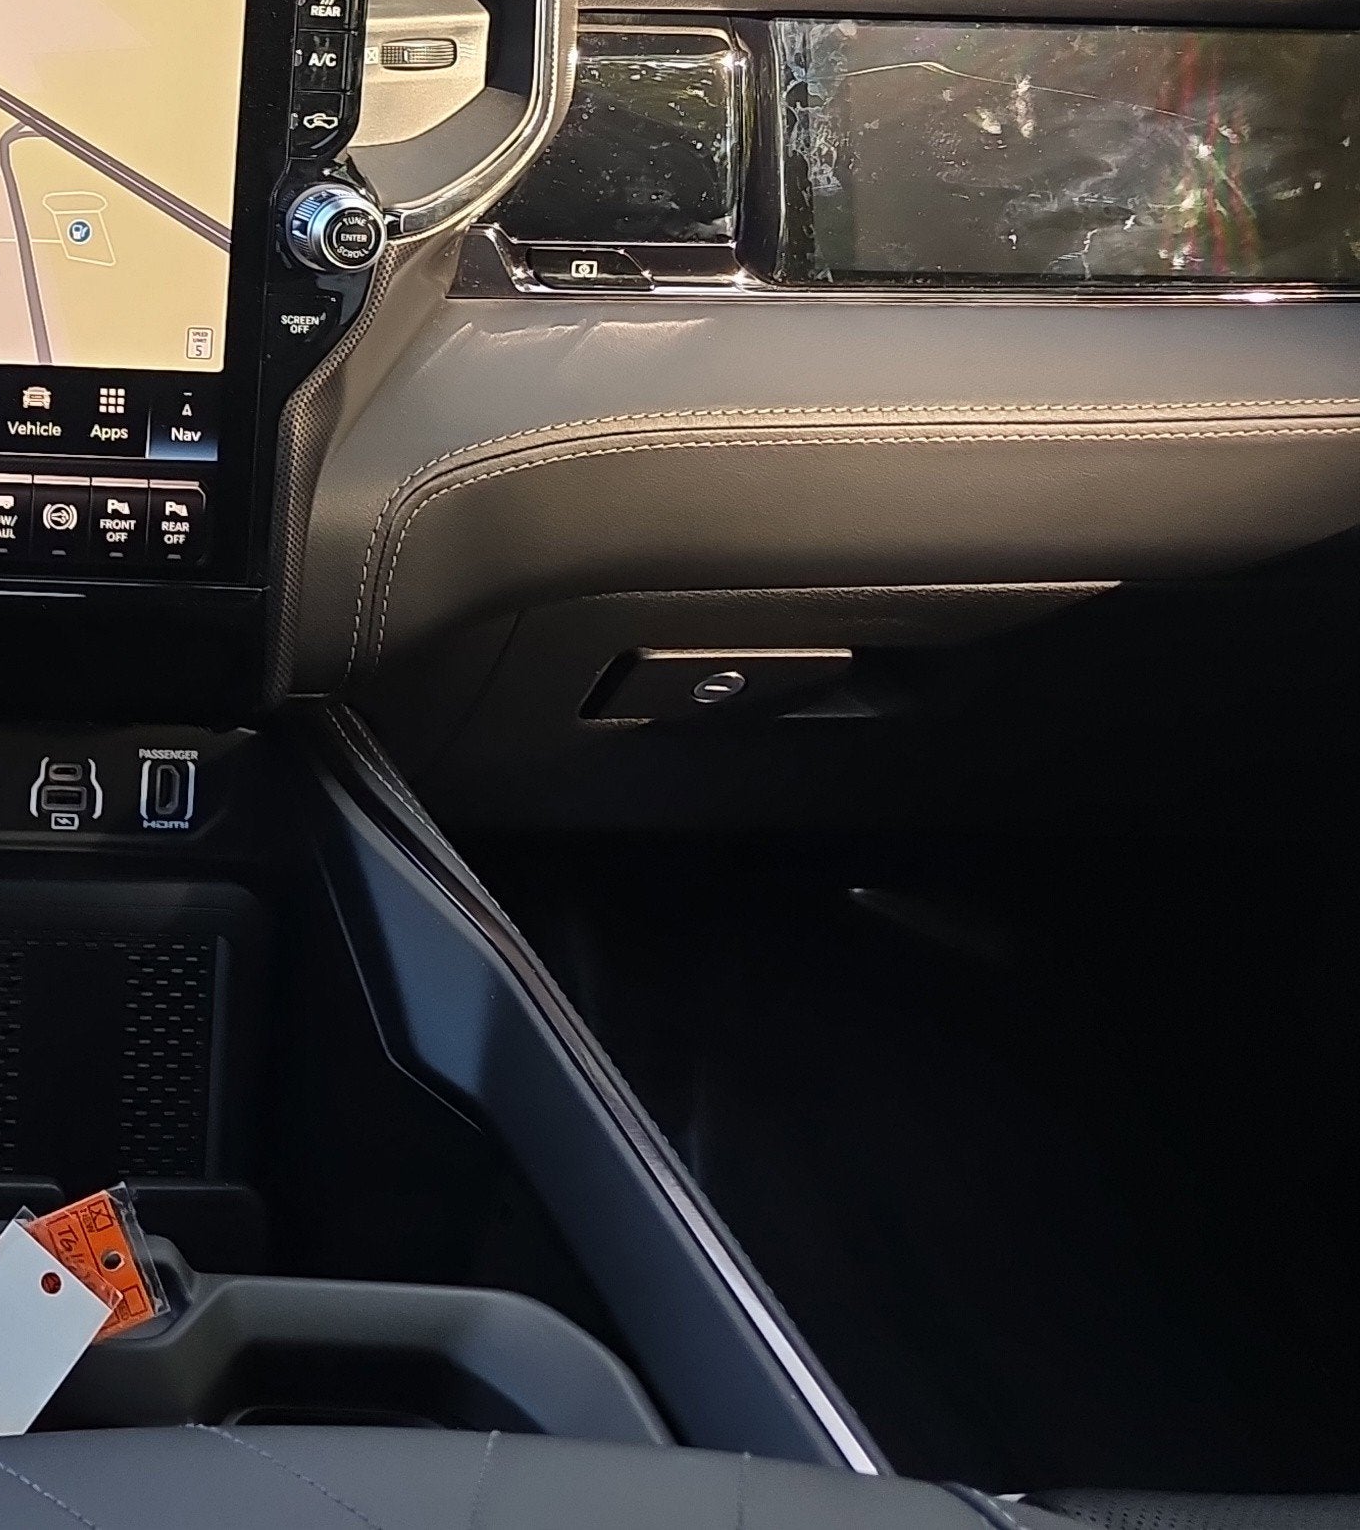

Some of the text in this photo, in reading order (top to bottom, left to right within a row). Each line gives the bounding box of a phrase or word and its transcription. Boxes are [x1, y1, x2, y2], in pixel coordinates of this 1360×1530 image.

[309, 5, 341, 18] REAR
[307, 52, 337, 68] A/C
[341, 216, 368, 228] TUNE
[339, 232, 369, 244] ENTER
[335, 244, 370, 260] SCROLL
[279, 313, 321, 326] SCREEN
[288, 324, 311, 335] OFF
[195, 344, 203, 357] 5
[6, 420, 63, 437] Vehicle
[89, 423, 129, 442] Apps
[170, 426, 202, 443] Nav
[98, 518, 137, 532] FRONT
[160, 520, 190, 533] REAR
[105, 531, 130, 544] OFF
[163, 532, 187, 546] OFF
[137, 747, 200, 761] PASSENGER
[141, 819, 190, 830] HDMI
